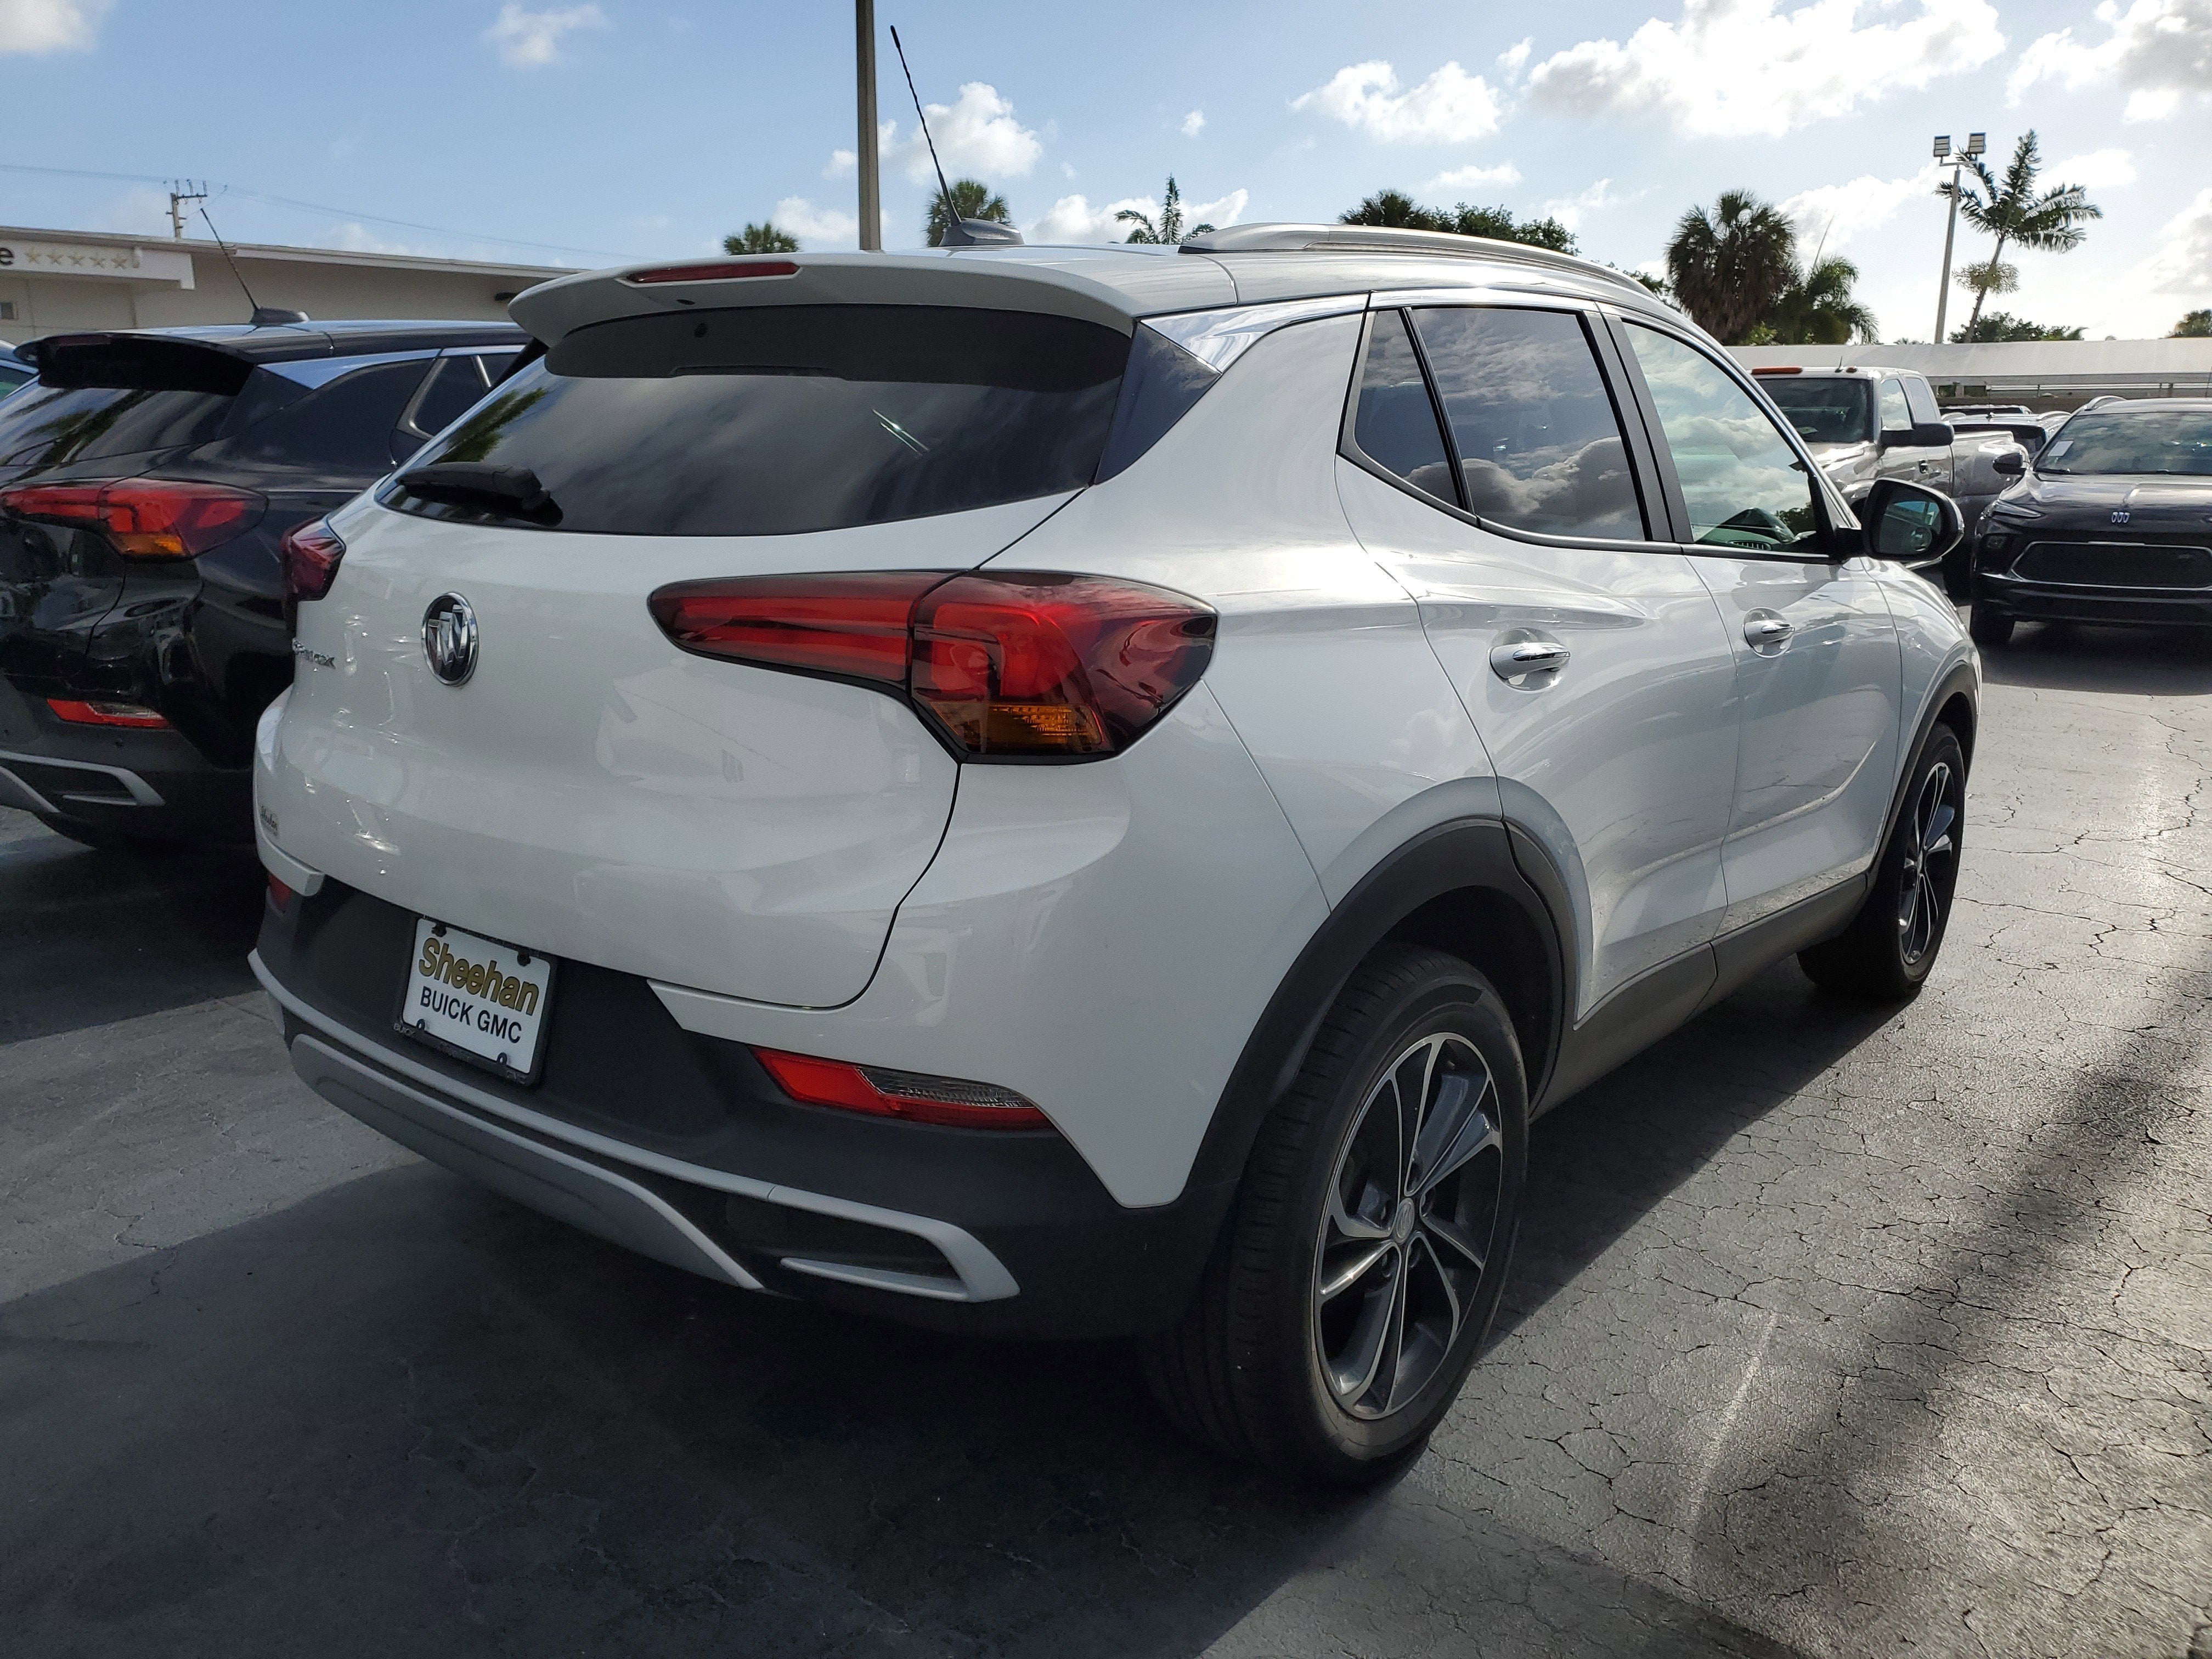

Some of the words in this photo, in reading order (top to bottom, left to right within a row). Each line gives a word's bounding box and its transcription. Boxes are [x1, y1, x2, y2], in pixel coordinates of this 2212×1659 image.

[419, 938, 539, 1015] Sheehan
[420, 986, 473, 1025] BUICK
[477, 1010, 521, 1043] GMC
